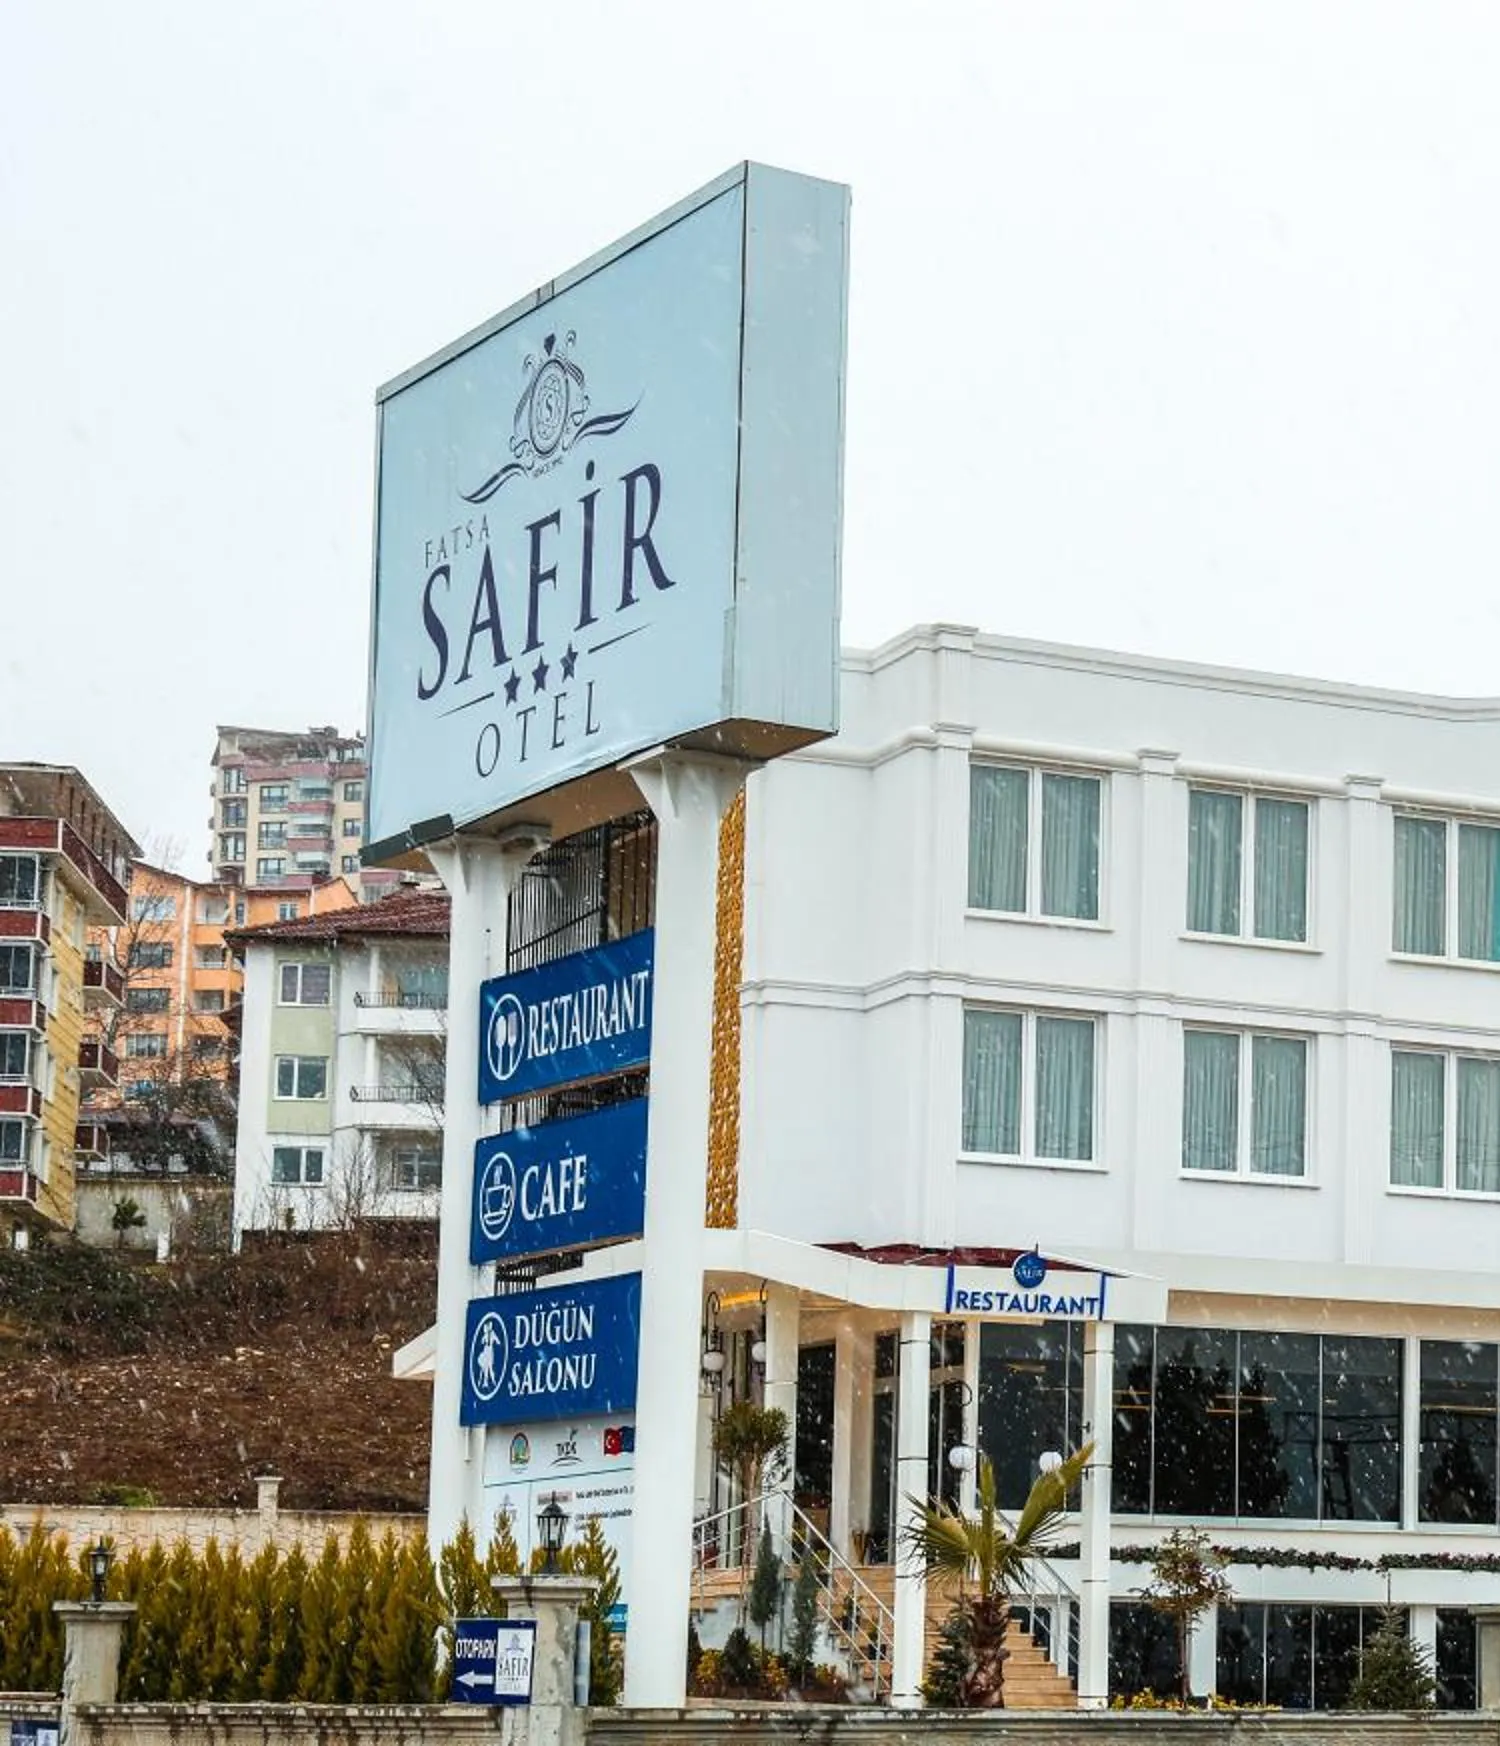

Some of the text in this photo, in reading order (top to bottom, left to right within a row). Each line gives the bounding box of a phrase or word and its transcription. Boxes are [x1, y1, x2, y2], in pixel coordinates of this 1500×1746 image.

[424, 514, 491, 569] FATSA
[417, 459, 677, 701] SAFİR
[475, 680, 602, 779] OTEL
[526, 970, 649, 1060] RESTAURANT
[520, 1154, 588, 1221] CAFE
[514, 1300, 595, 1349] DÜĞÜN
[955, 1290, 1100, 1315] RESTAURANT
[508, 1353, 597, 1397] SALONU
